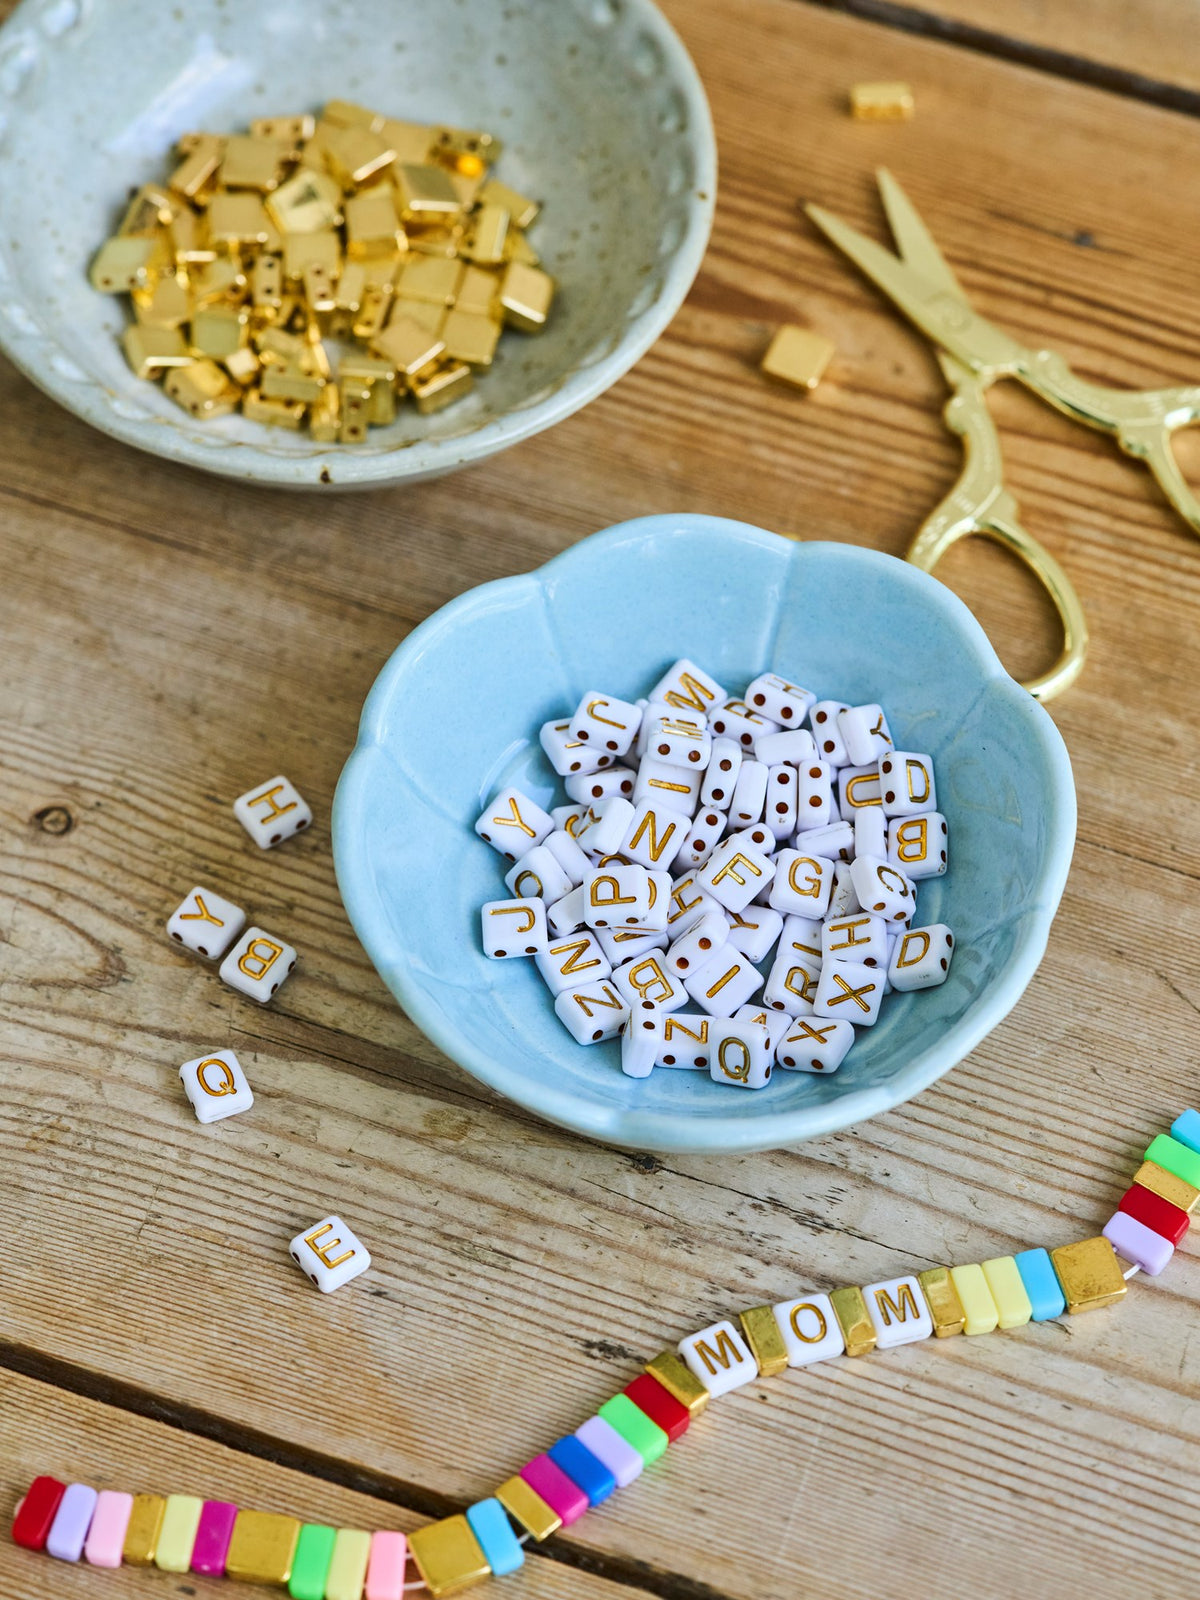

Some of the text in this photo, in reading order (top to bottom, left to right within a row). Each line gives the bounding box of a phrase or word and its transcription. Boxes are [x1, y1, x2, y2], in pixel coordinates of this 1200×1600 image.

[586, 699, 627, 730] J
[905, 759, 930, 804] D
[247, 784, 298, 825] H
[492, 797, 537, 838] Y
[629, 810, 677, 862] N
[896, 818, 927, 863] B
[711, 852, 762, 886] F
[788, 856, 823, 899] G
[590, 875, 637, 907] P
[667, 878, 703, 924] H
[179, 894, 225, 928] Y
[489, 906, 536, 933] J
[829, 917, 871, 951] H
[896, 931, 931, 969] D
[238, 937, 284, 981] B
[550, 938, 601, 976] N
[628, 957, 675, 1003] B
[706, 964, 741, 999] I
[784, 966, 819, 1004] R
[827, 974, 876, 1013] X
[786, 1020, 837, 1044] X
[196, 1058, 238, 1098] Q
[718, 1036, 750, 1084] Q
[304, 1223, 356, 1270] E
